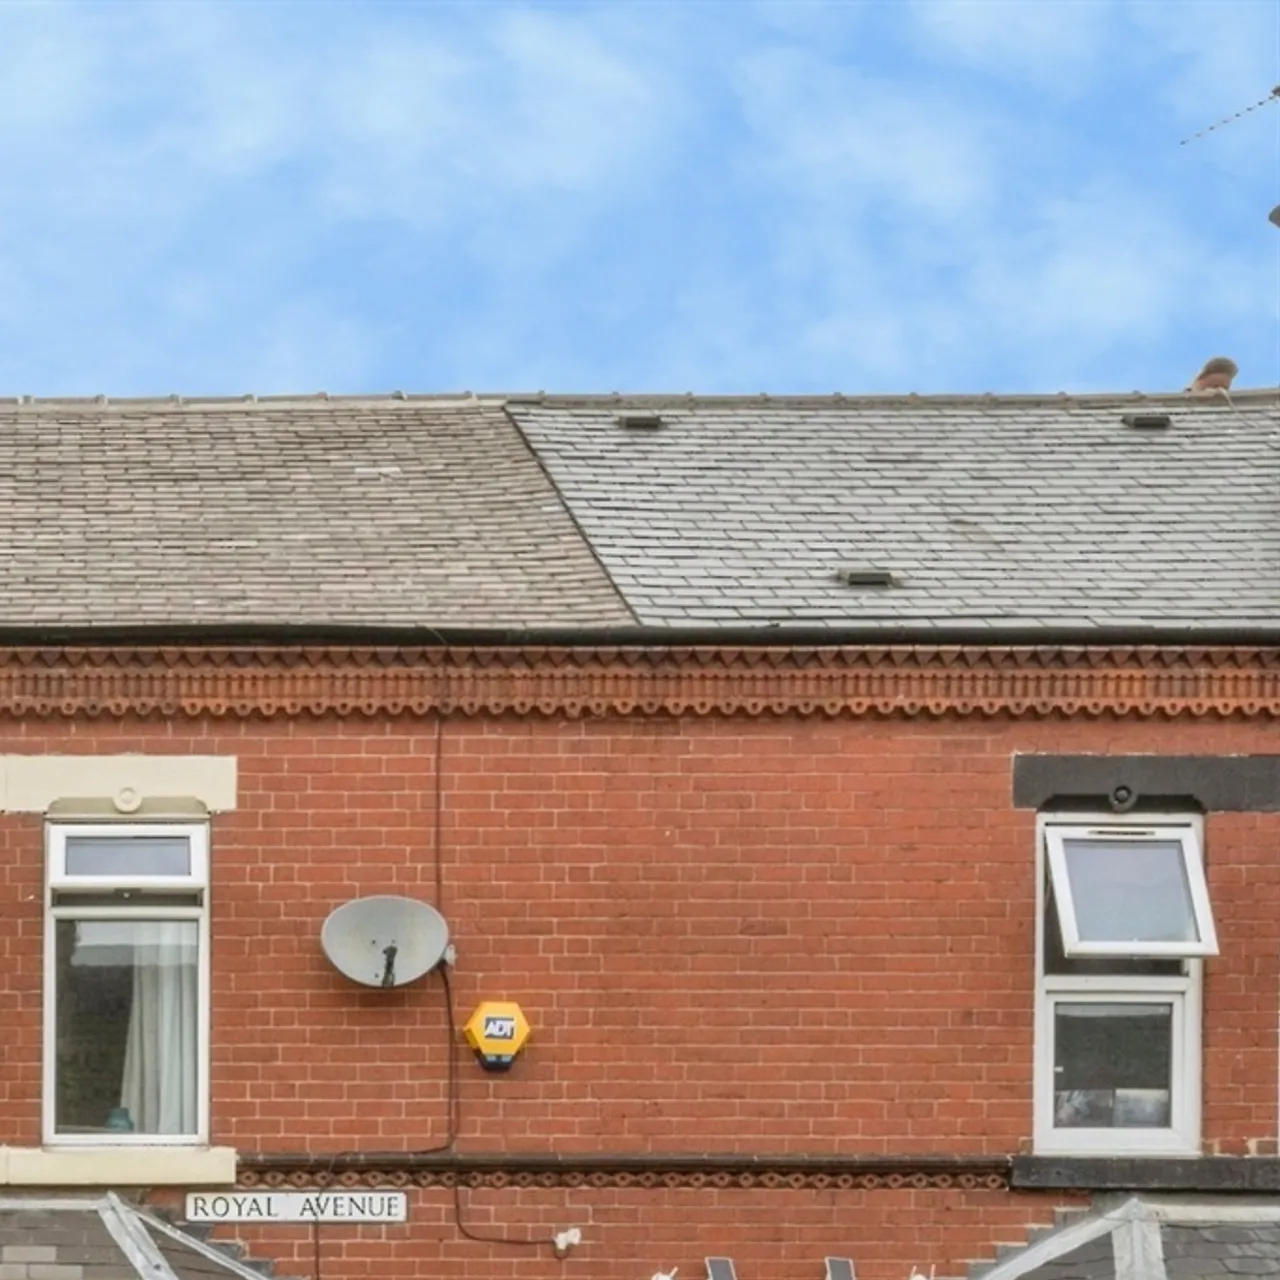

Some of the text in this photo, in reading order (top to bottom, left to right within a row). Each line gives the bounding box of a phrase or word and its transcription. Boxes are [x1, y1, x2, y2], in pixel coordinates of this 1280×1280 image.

[484, 1019, 515, 1036] ADT
[193, 1195, 399, 1217] ROYAL AVENUE
